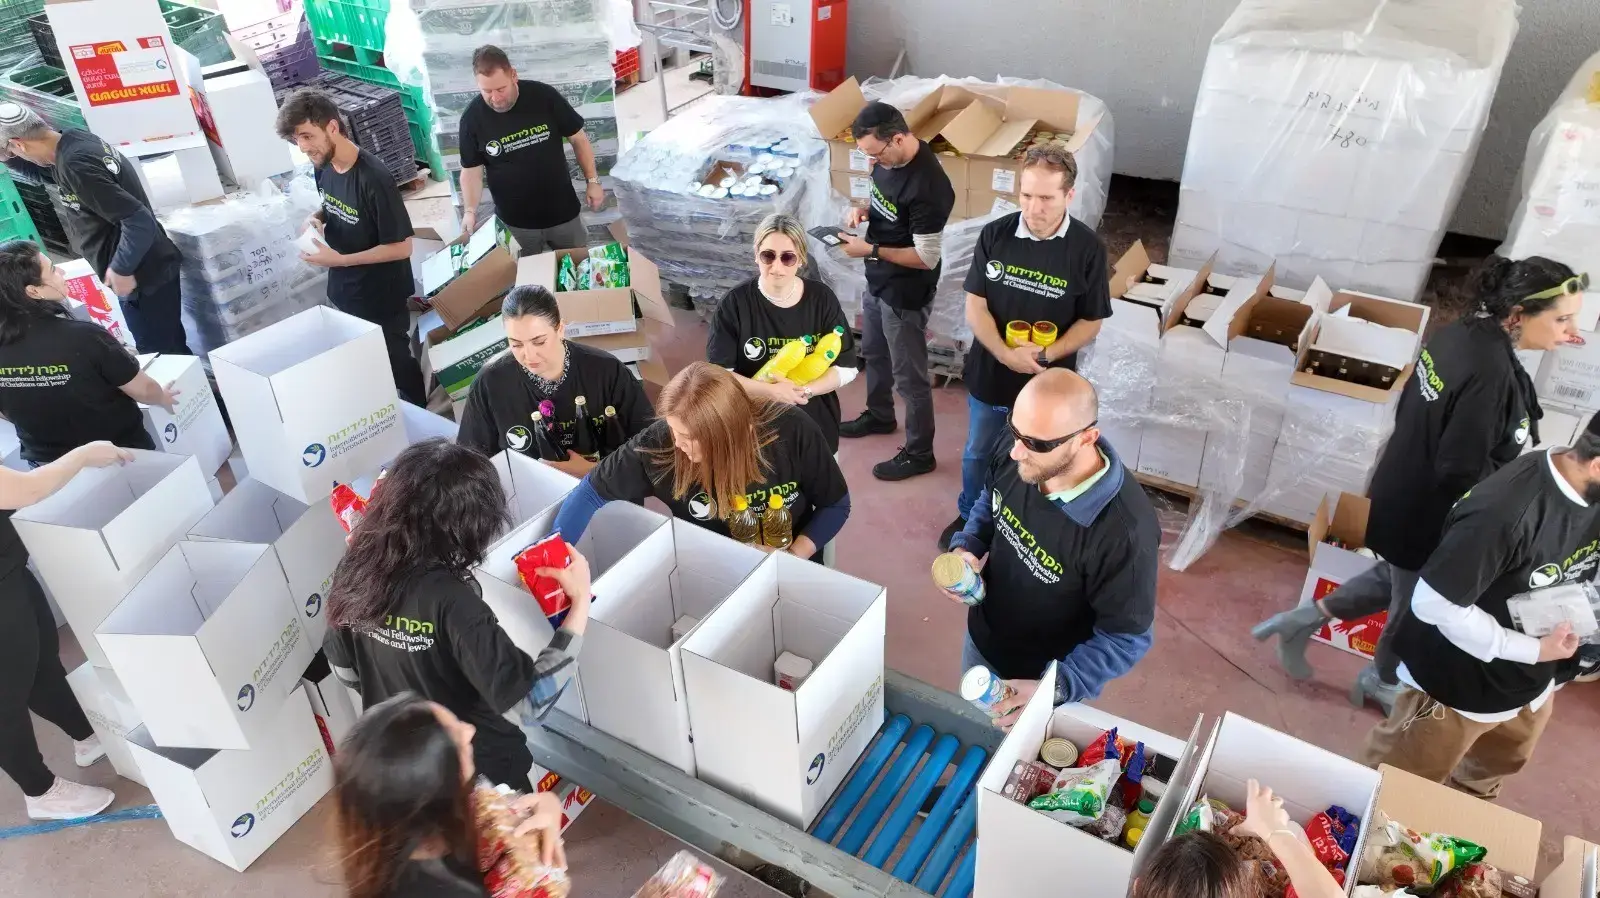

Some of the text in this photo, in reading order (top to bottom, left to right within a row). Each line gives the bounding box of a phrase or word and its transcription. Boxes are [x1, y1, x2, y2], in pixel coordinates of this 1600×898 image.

[90, 83, 172, 102] משפחה אחת!
[500, 123, 549, 144] הקרן לידידות
[1004, 273, 1066, 297] International Fellowship
[1006, 264, 1068, 288] הקרן לידידות
[1009, 280, 1035, 293] Christians
[1035, 289, 1047, 297] and
[455, 341, 507, 370] פריכוני אורז
[35, 373, 72, 381] Fellowship
[37, 364, 69, 376] הקרן
[327, 403, 395, 446] הקרן לידידות
[329, 413, 397, 453] International Fellowship
[339, 437, 369, 455] Christians
[369, 429, 381, 439] and
[769, 481, 798, 498] הקרן
[997, 523, 1003, 531] of
[1023, 557, 1035, 572] and
[999, 515, 1060, 583] International Fellowship
[1002, 505, 1063, 575] הקרן לידידות
[396, 616, 434, 634] הקרן
[253, 617, 298, 682] הקרן לידידות
[390, 640, 406, 650] and
[391, 630, 434, 649] Fellowship
[255, 748, 321, 810] הקרן לידידות
[258, 756, 324, 817] International Fellowship
[267, 788, 297, 815] Christians
[296, 777, 308, 789] and
[1061, 797, 1080, 807] אורז
[1312, 836, 1329, 854] לבן
